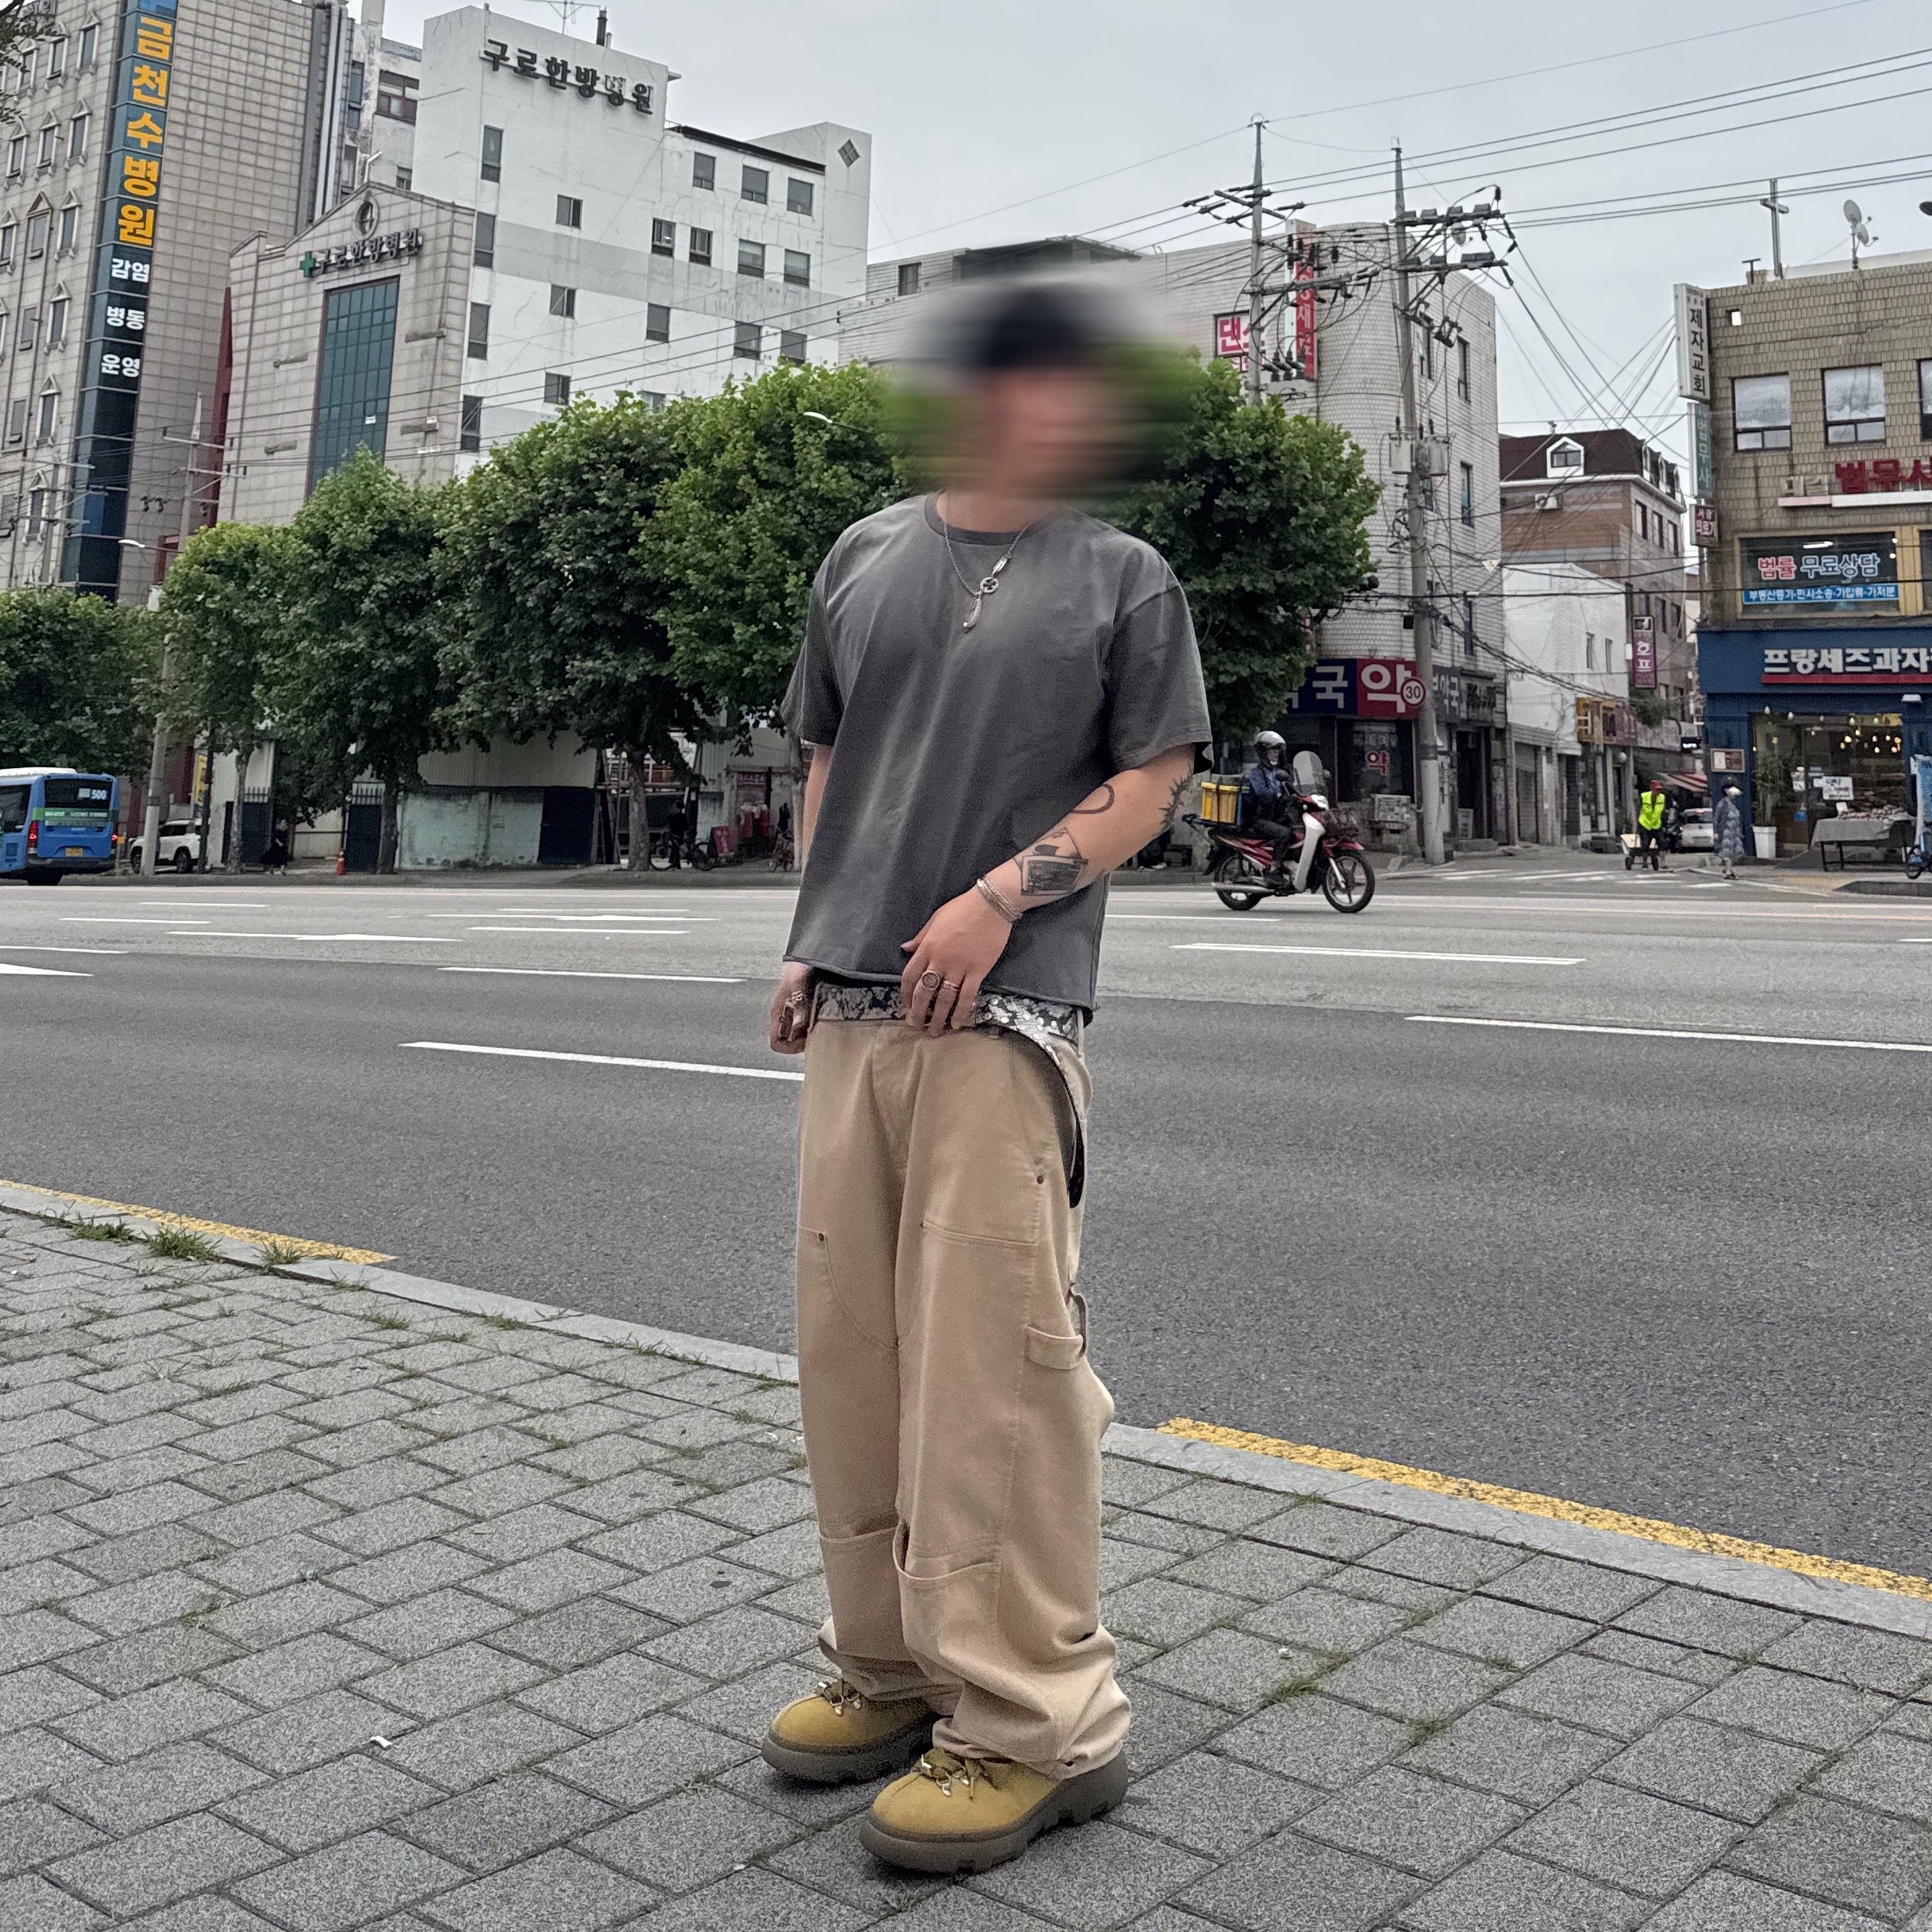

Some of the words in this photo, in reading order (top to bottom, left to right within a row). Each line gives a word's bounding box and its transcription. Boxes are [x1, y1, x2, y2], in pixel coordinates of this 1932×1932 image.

[484, 38, 653, 115] 구로한방병원
[117, 15, 173, 247] 금천수병원
[314, 228, 421, 275] 구로한방병원
[111, 258, 150, 283] 감염
[106, 306, 145, 330] 병동
[1690, 308, 1705, 396] 제자교회
[101, 354, 141, 378] 운영
[1758, 556, 1796, 580] 법률
[1800, 552, 1880, 579] 무료상담
[1764, 648, 1932, 675] 프랑세즈과자
[1361, 663, 1413, 713] 약
[1405, 685, 1421, 700] 30
[1365, 750, 1390, 775] 약
[91, 789, 107, 800] 500
